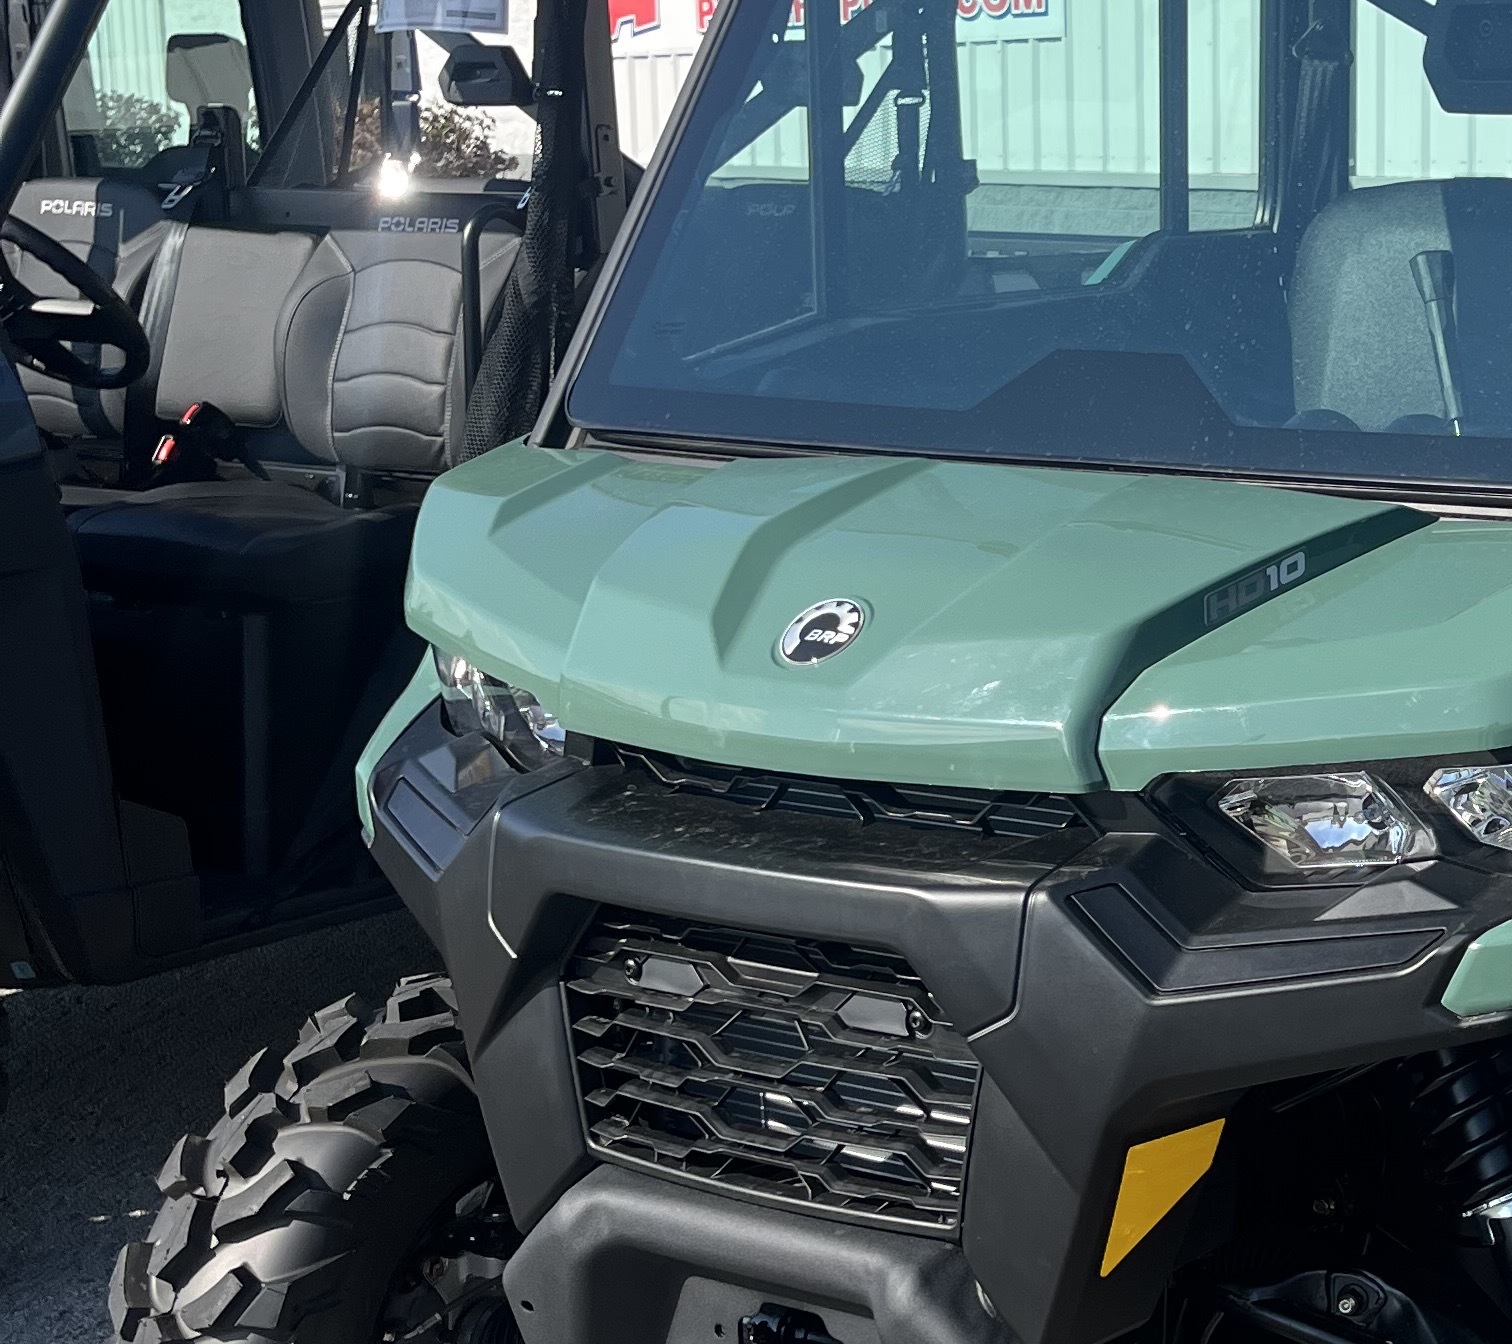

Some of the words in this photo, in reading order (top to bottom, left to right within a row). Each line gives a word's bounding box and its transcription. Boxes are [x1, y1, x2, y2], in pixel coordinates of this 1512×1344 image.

[40, 199, 113, 217] POLARIS
[378, 216, 459, 233] POLARIS
[1209, 551, 1306, 621] HD10
[804, 628, 850, 645] BRP
